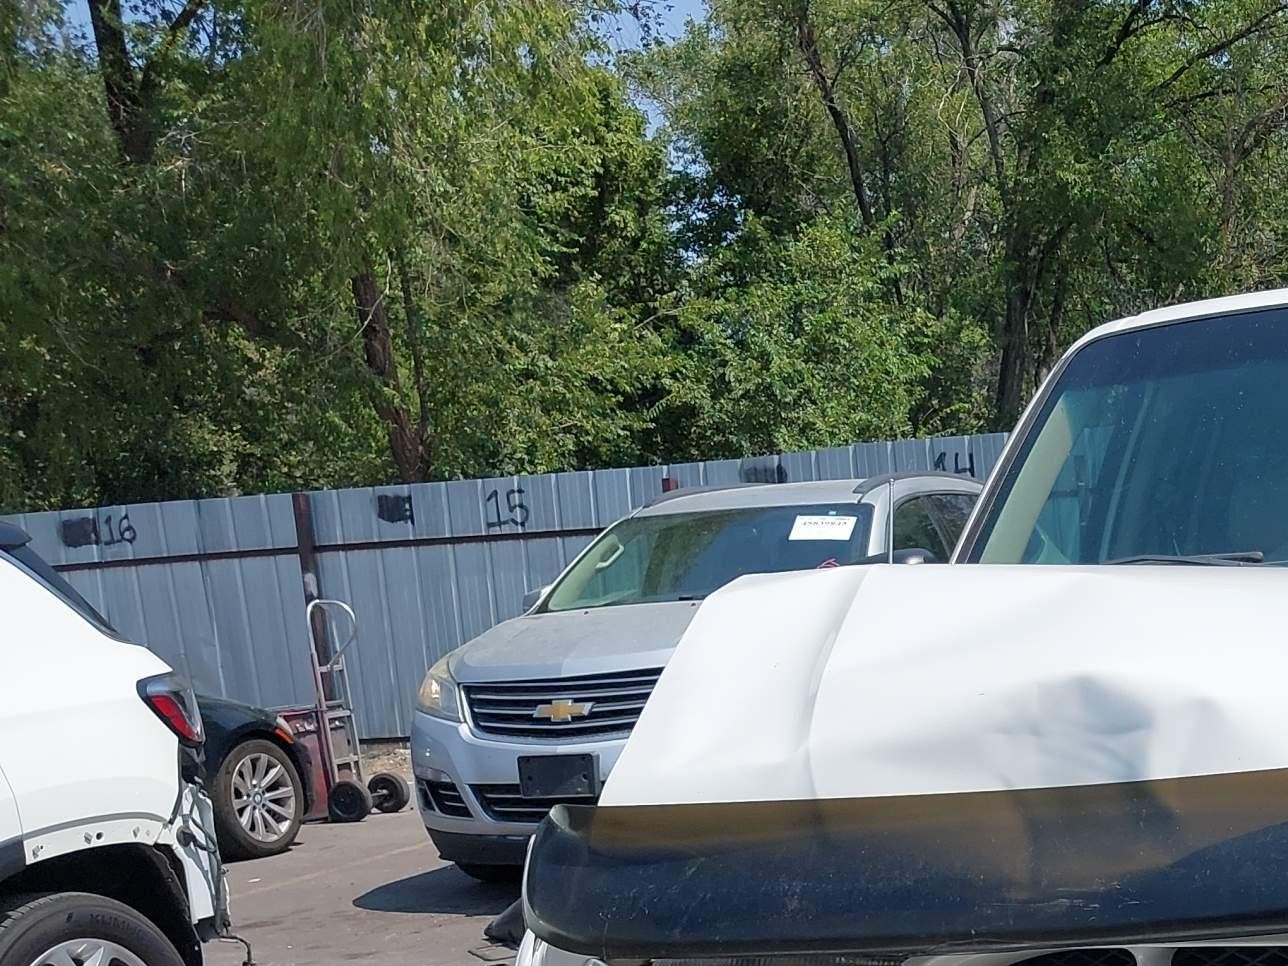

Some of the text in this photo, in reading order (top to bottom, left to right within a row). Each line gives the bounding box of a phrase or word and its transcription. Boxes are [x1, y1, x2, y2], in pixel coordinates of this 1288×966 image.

[934, 451, 976, 478] 14
[486, 488, 529, 529] 15
[103, 512, 137, 546] 16
